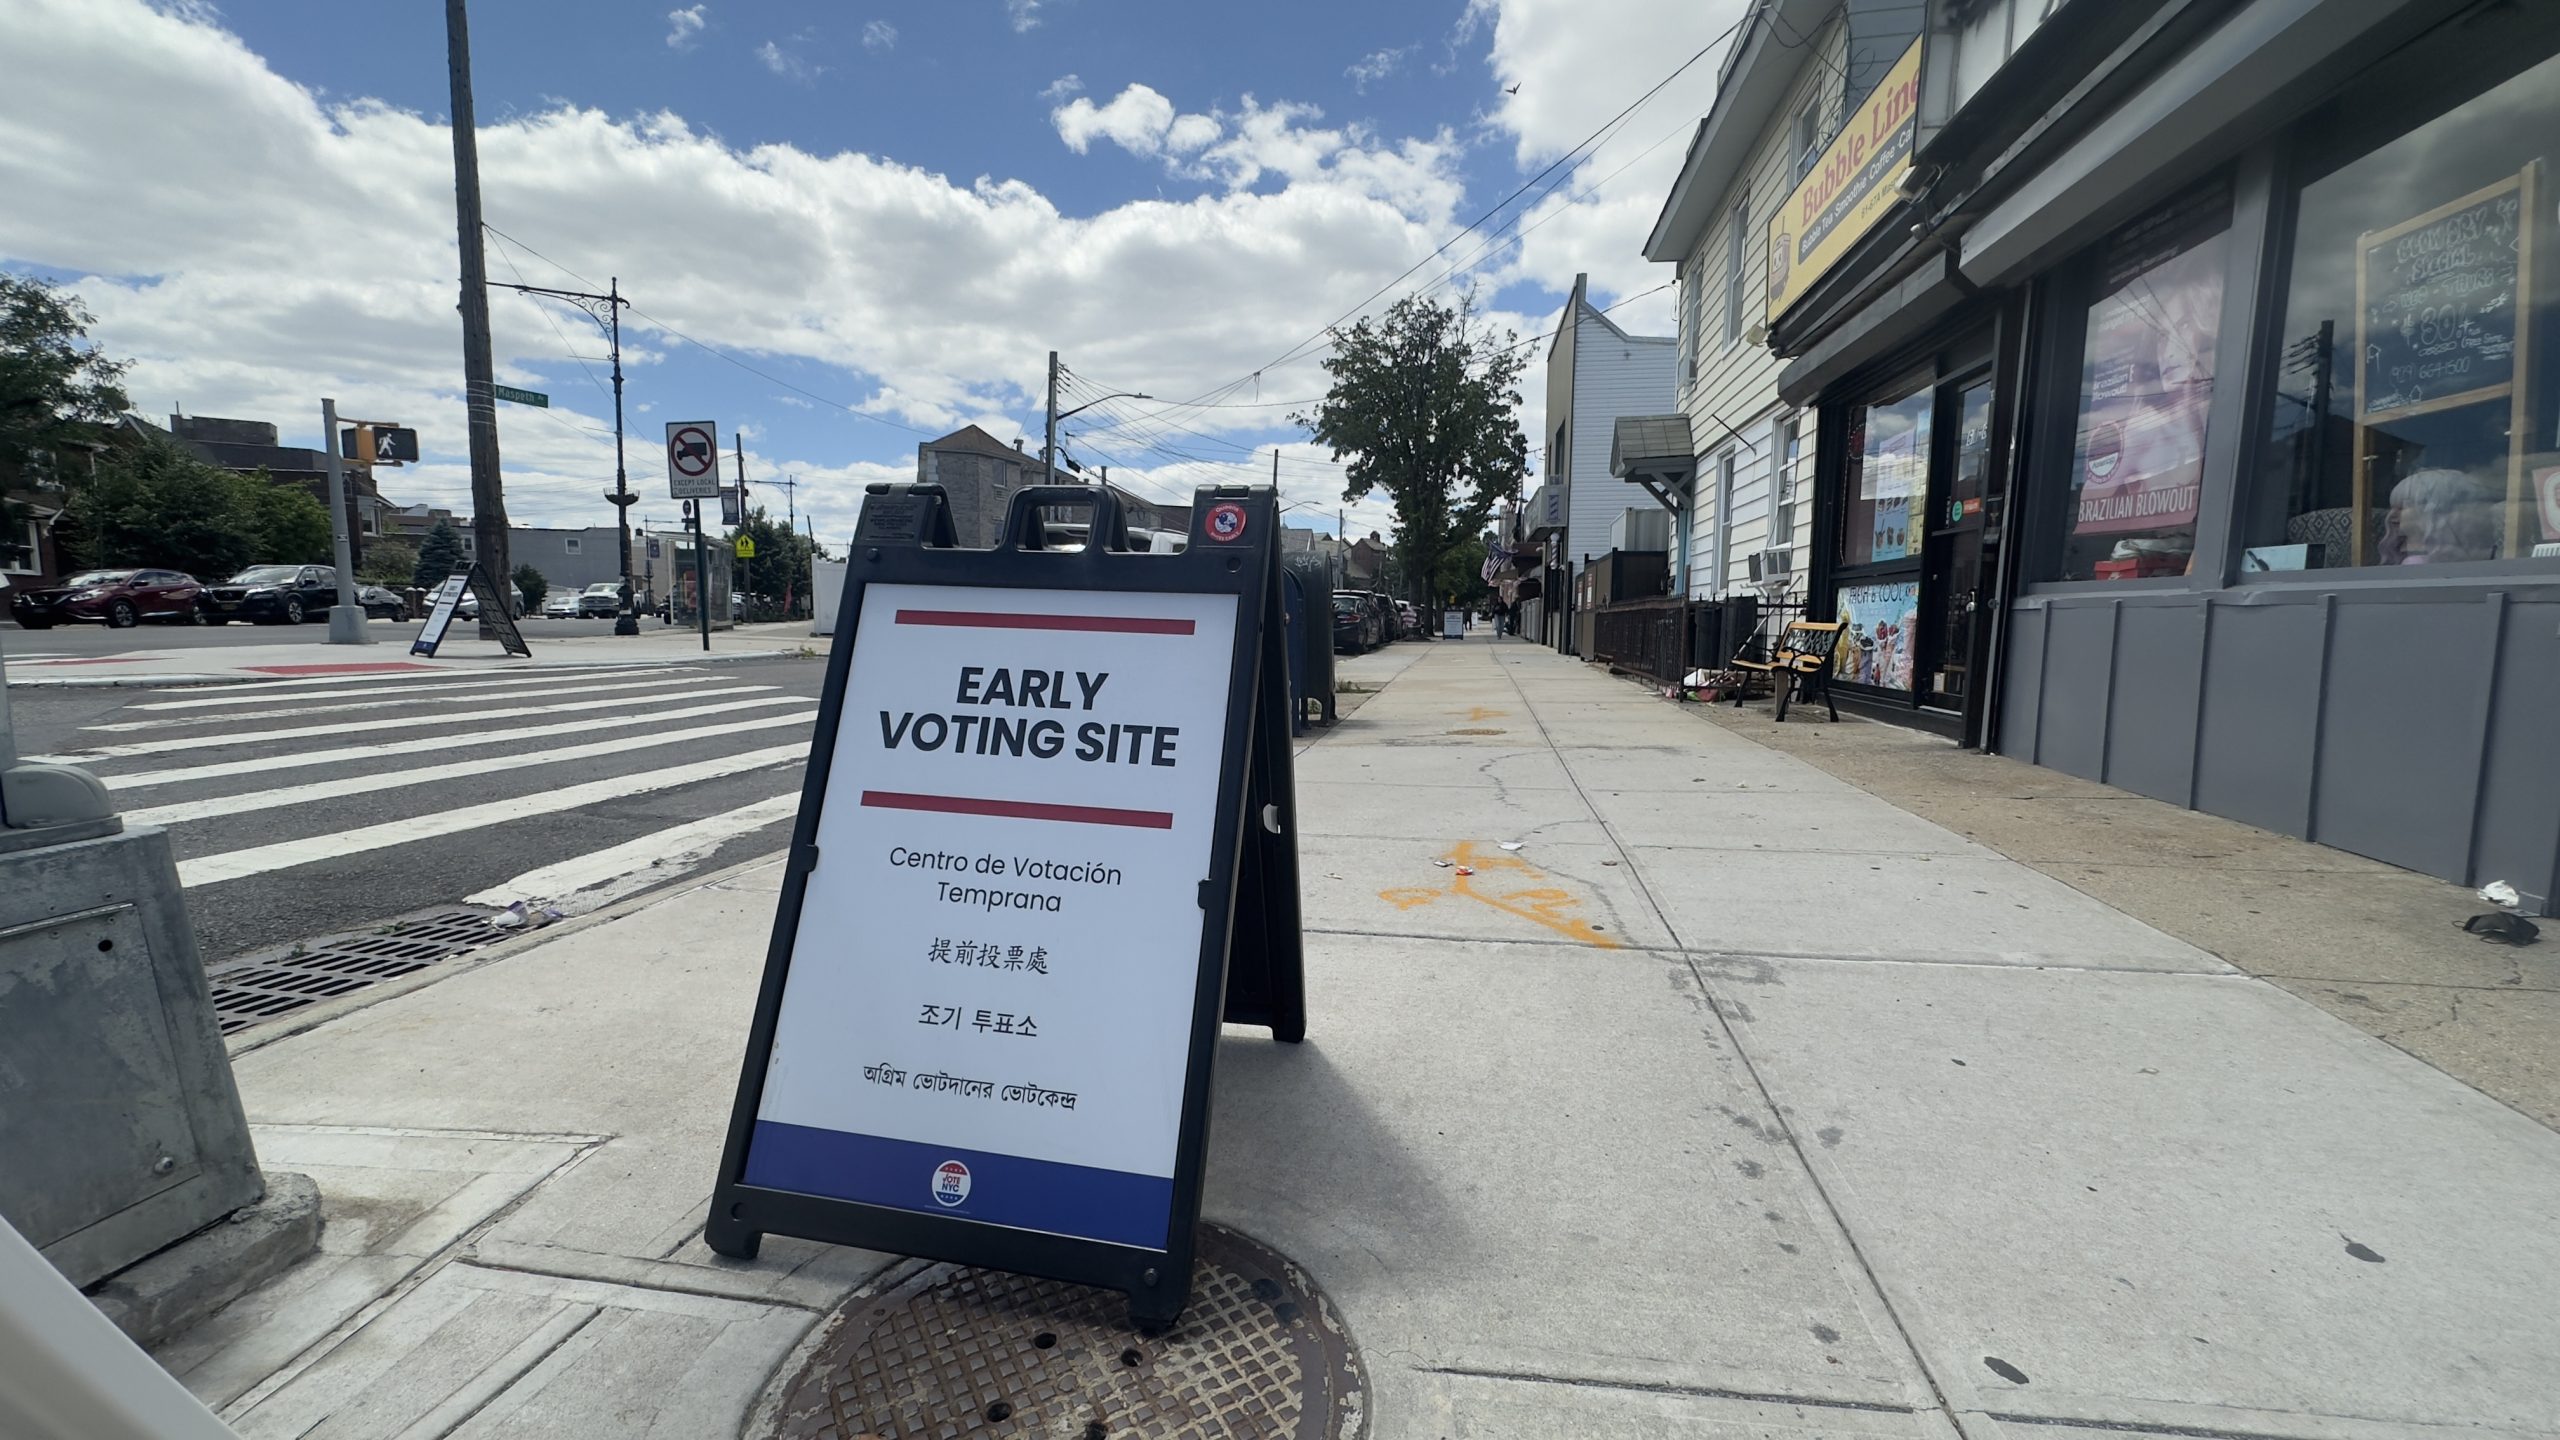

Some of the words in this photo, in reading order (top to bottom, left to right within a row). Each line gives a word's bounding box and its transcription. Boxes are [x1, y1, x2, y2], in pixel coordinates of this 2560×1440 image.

[1802, 133, 1865, 227] Bubble
[1822, 212, 1834, 231] Tea
[1834, 176, 1867, 217] Smoothie
[1870, 147, 1895, 180] Coffee
[498, 386, 534, 402] Maspeth
[674, 479, 695, 487] EXCEPT
[2078, 495, 2133, 522] BRAZILIAN
[2135, 486, 2196, 517] BLOWOUT
[956, 666, 1109, 711] EARLY
[879, 711, 1065, 759] VOTING
[1075, 722, 1179, 767] SITE
[889, 847, 969, 875] Centro
[975, 851, 1006, 876] de
[1013, 856, 1122, 886] Votación
[937, 882, 1062, 913] Temprana
[928, 937, 1049, 975] 提前投票處
[918, 1004, 962, 1031] 조기
[972, 1009, 1038, 1038] 투표소
[863, 1062, 907, 1088] অগ্রিম
[913, 1070, 995, 1099] ভোটদানের
[1001, 1081, 1078, 1111] ভোটকেন্দ্র
[942, 1184, 960, 1193] NYC
[943, 1174, 960, 1184] VOTE
